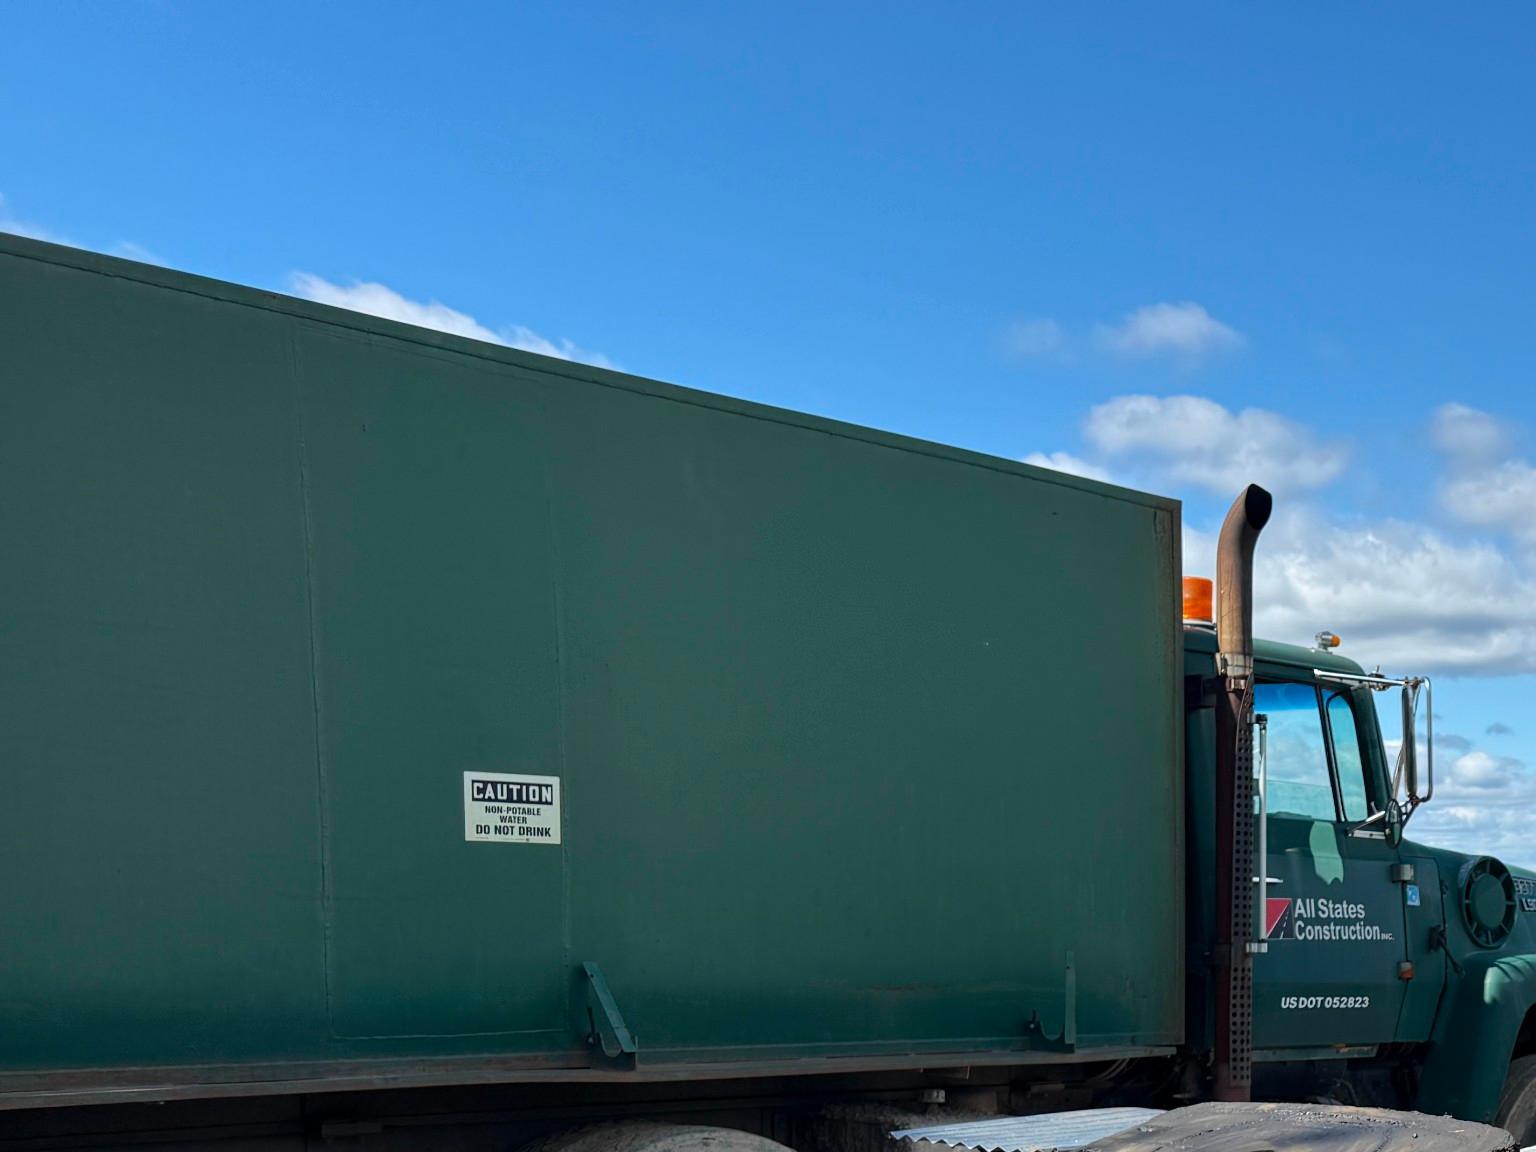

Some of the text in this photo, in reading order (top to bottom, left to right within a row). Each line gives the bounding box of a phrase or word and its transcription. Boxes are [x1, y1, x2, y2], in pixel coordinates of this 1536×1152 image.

[473, 782, 552, 803] CAUTION
[485, 805, 541, 816] NON-POTABLE
[499, 815, 527, 825] WATER
[475, 824, 551, 837] DO NOT DRINK
[1295, 898, 1365, 918] All States
[1295, 920, 1381, 940] Construction
[1324, 996, 1369, 1008] 052823
